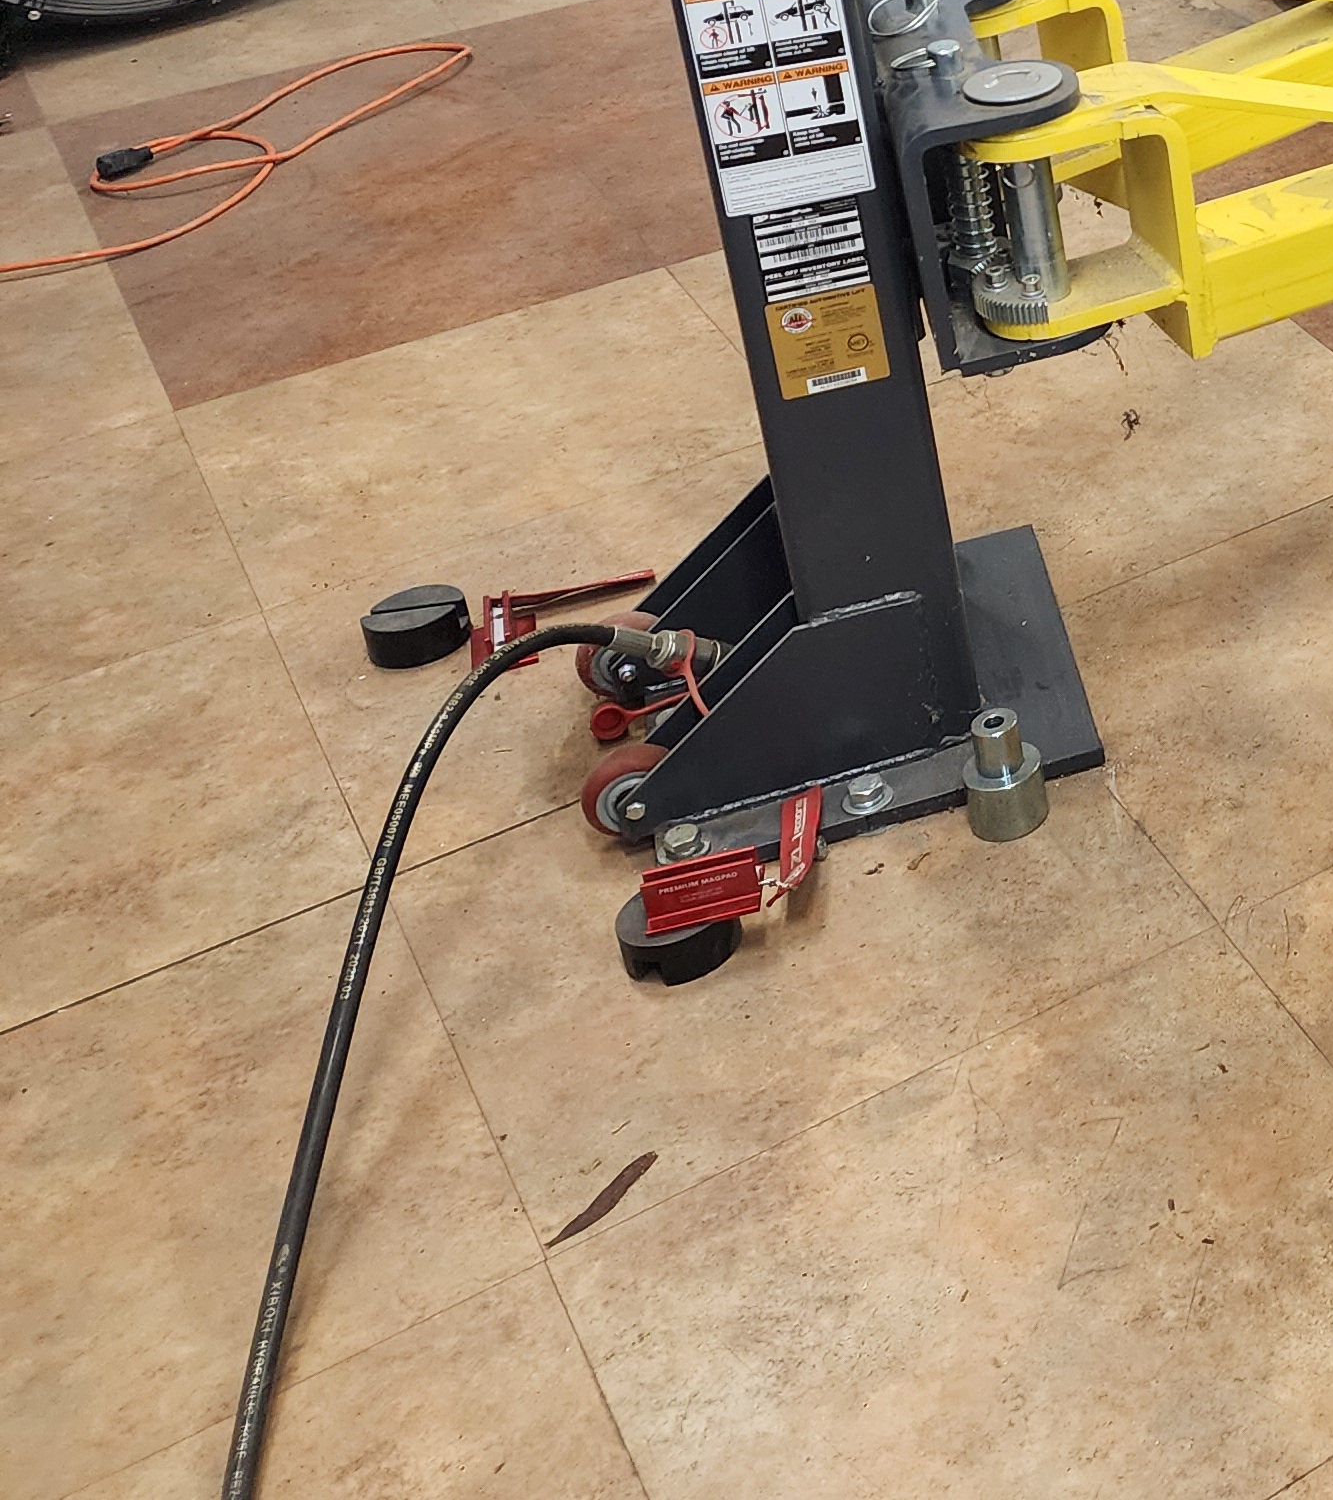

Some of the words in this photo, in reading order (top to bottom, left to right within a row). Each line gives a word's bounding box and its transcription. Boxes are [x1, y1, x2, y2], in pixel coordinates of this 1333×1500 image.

[796, 63, 843, 76] WARNING
[723, 75, 773, 89] WARNING
[465, 659, 491, 687] HOSE
[382, 783, 414, 848] MEE050070
[658, 880, 699, 895] PREMIUM
